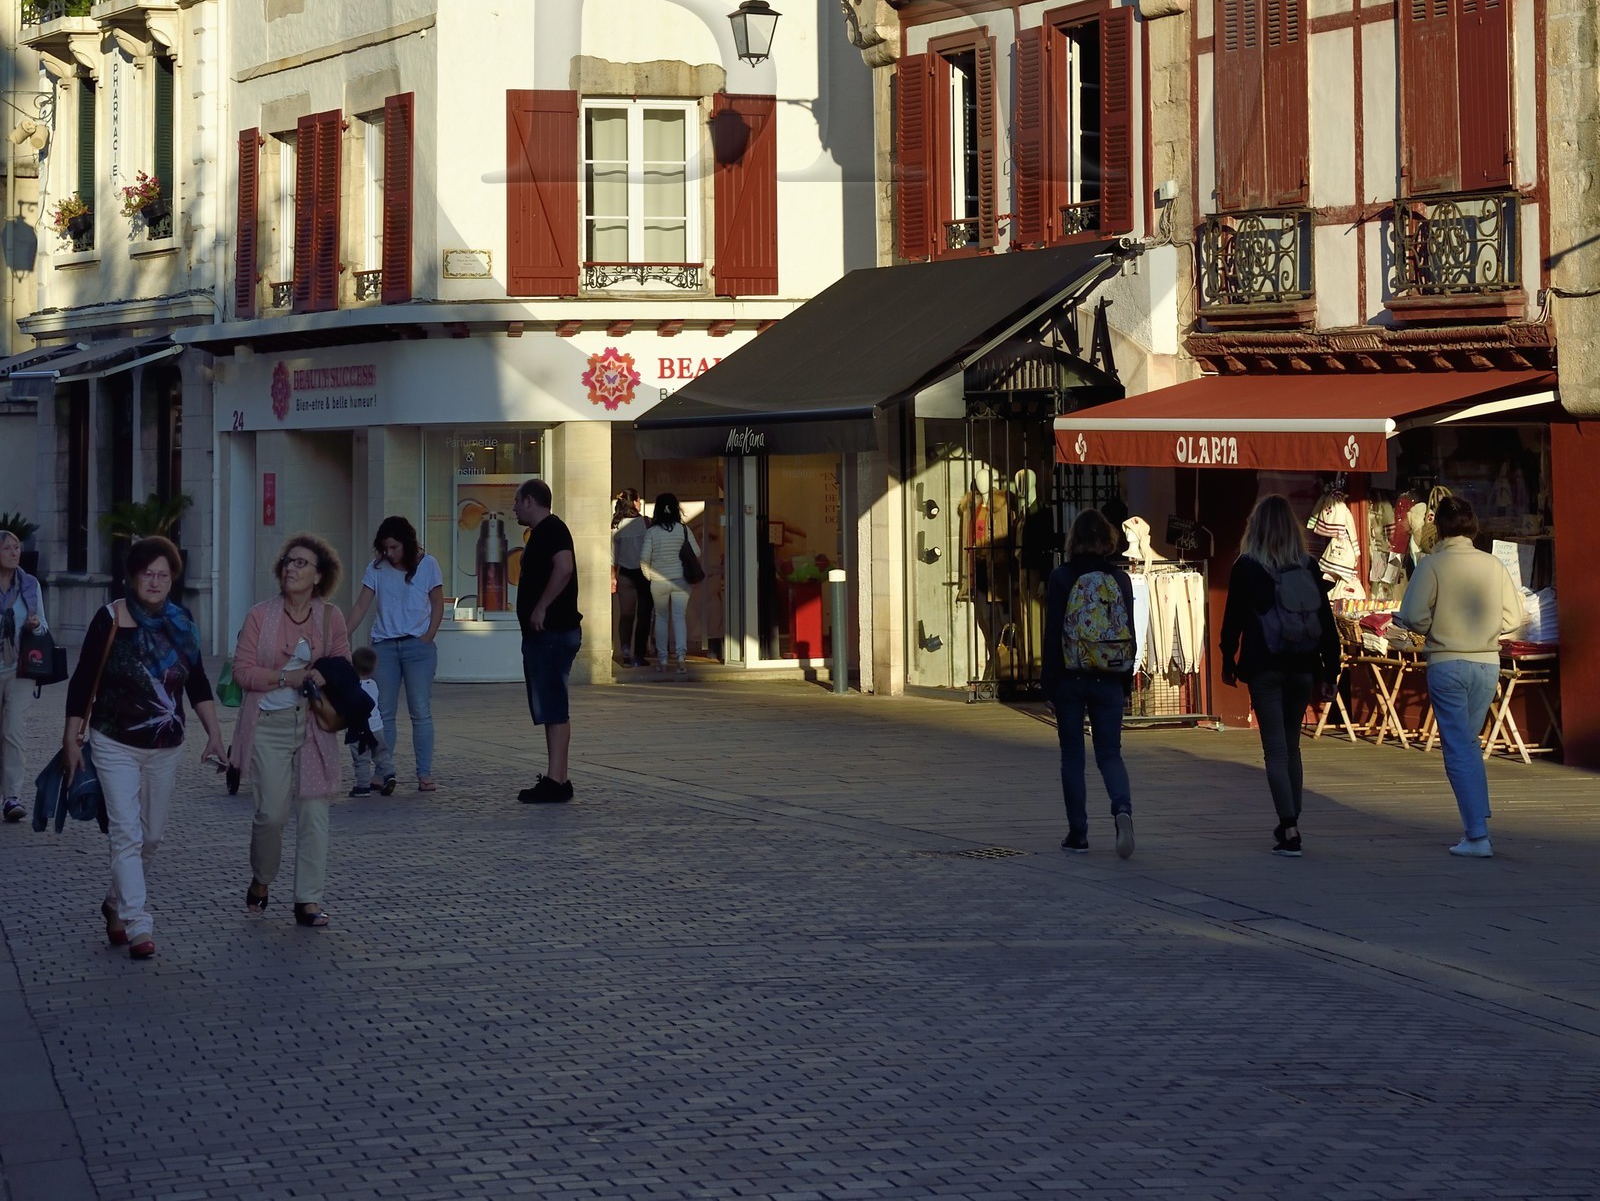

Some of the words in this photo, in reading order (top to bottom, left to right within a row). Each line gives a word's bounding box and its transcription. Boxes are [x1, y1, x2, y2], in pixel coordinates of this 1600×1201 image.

[293, 370, 328, 390] BEAUTY
[330, 365, 376, 388] SUCCESS
[658, 357, 722, 379] BEA
[332, 396, 348, 409] belle
[232, 410, 244, 431] 24
[445, 436, 499, 448] Parfumerie
[1176, 436, 1239, 465] OLARIA
[465, 451, 475, 462] &
